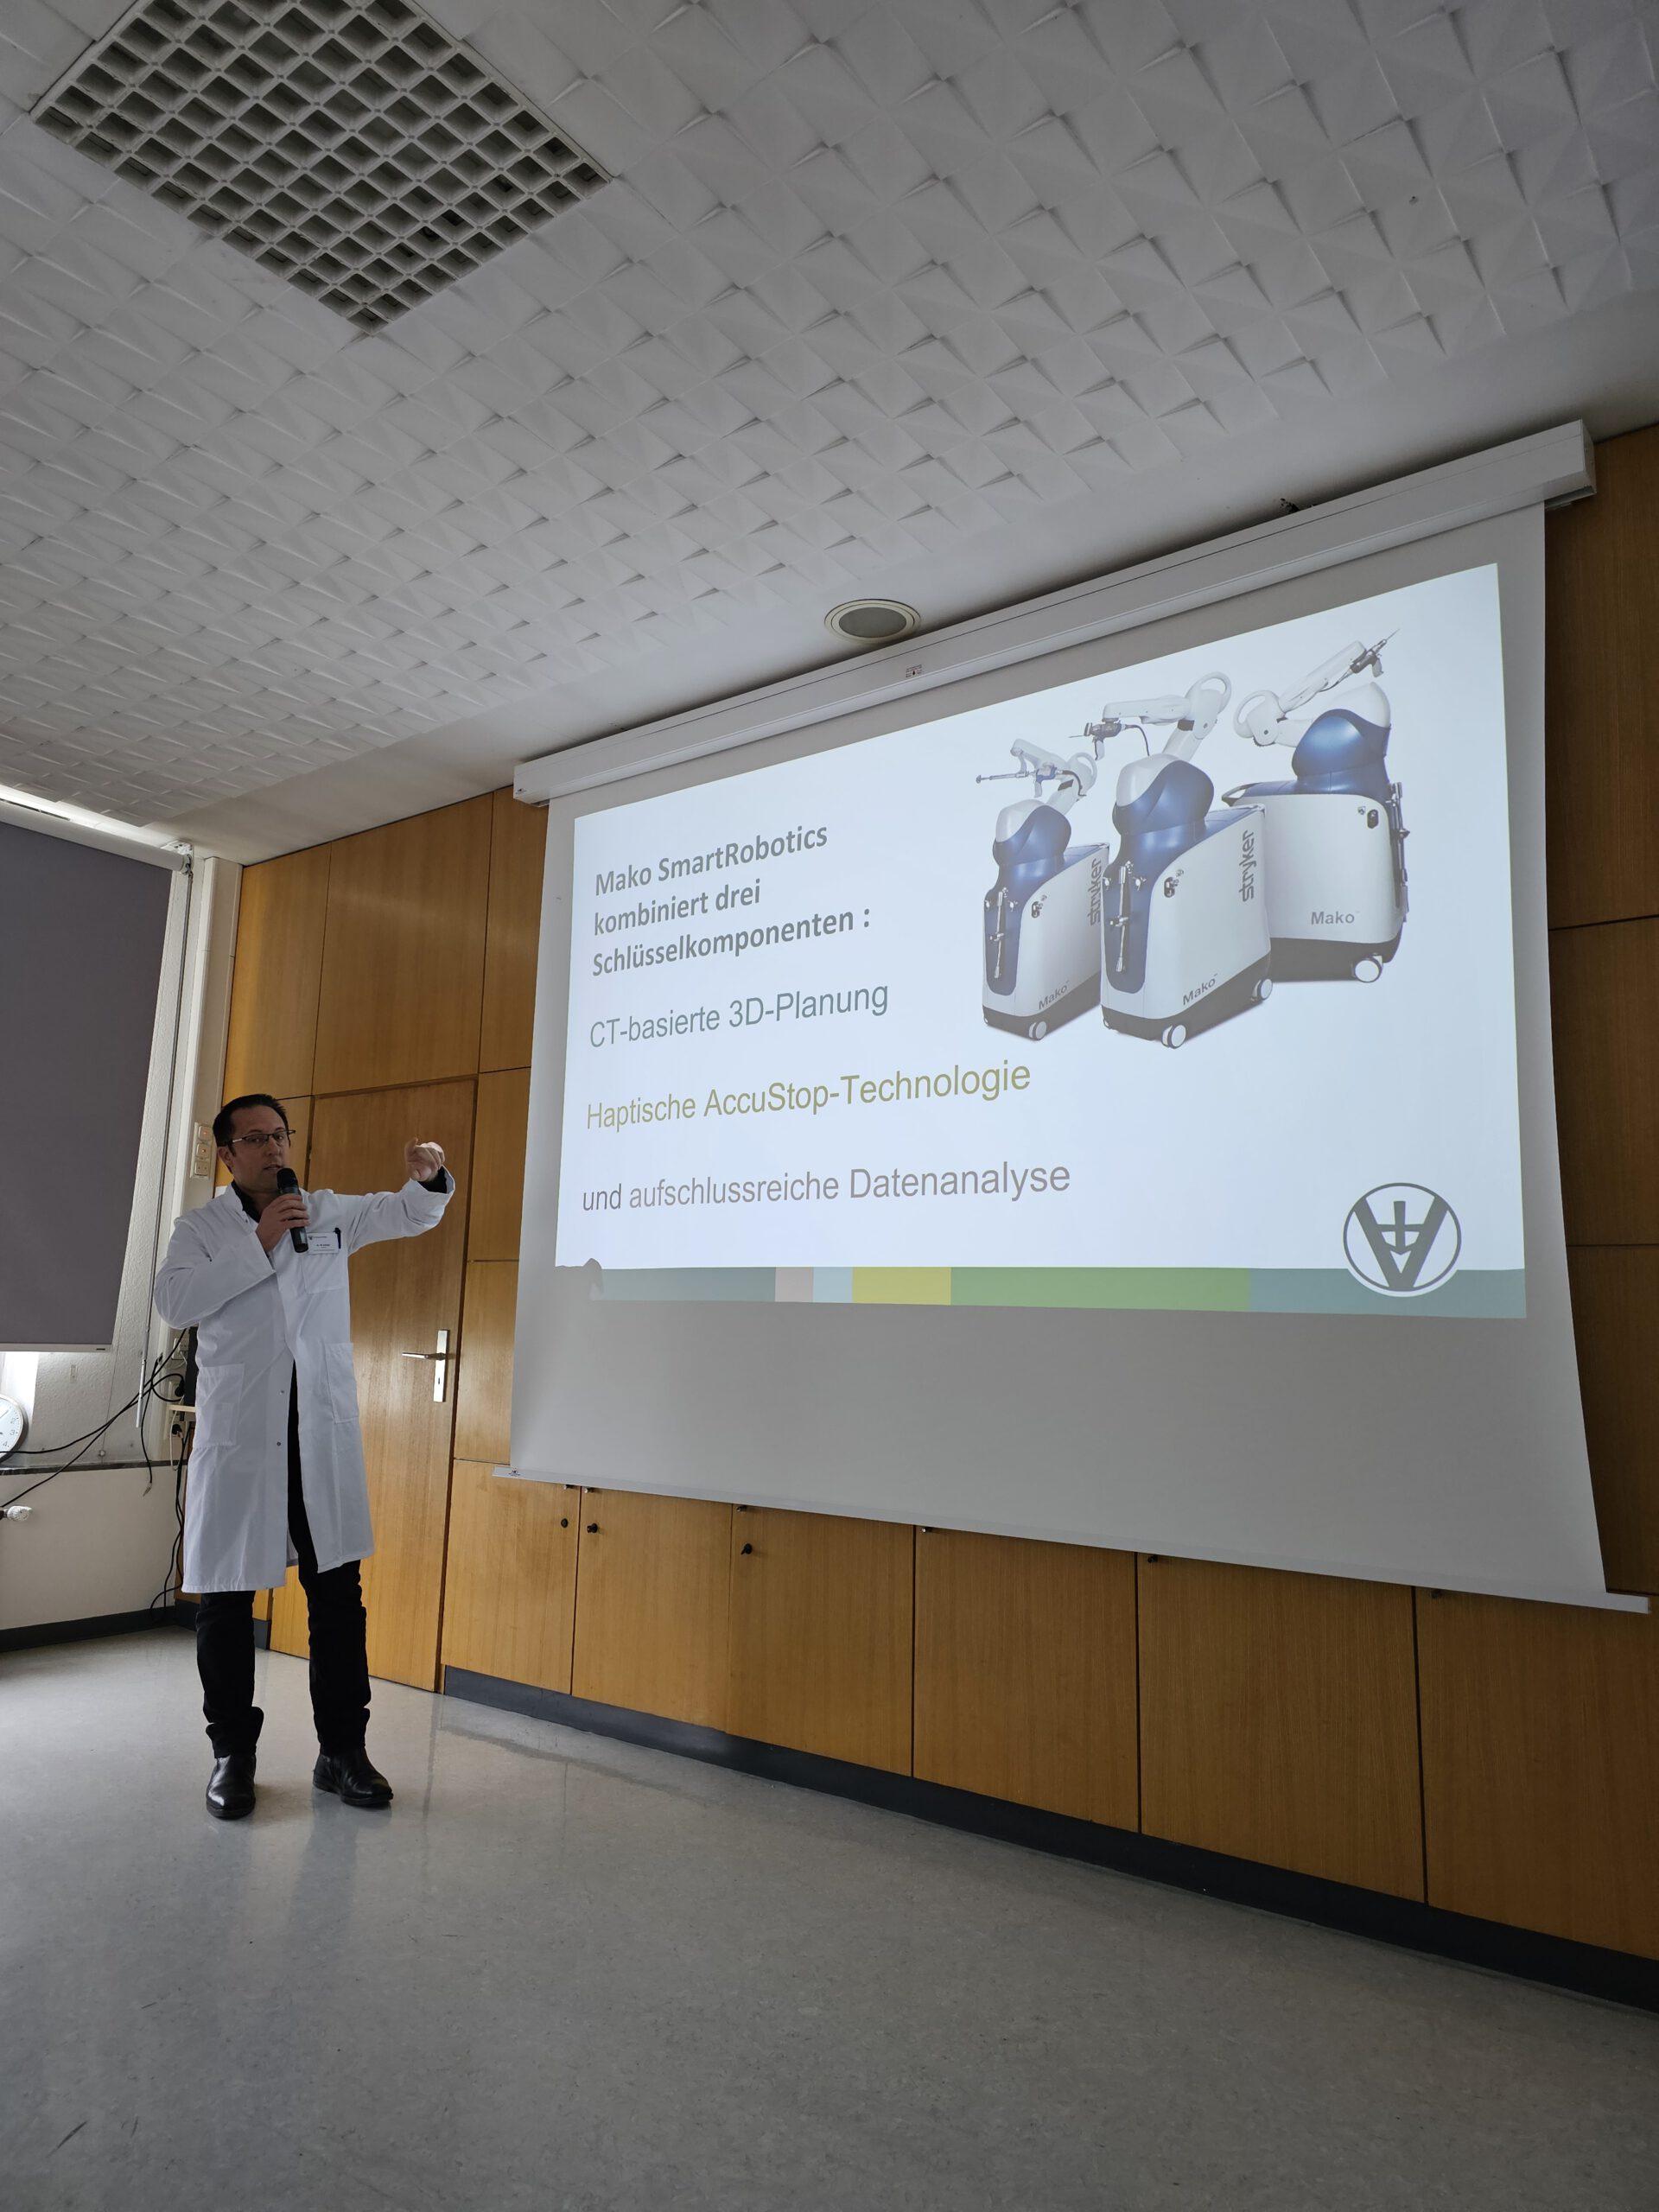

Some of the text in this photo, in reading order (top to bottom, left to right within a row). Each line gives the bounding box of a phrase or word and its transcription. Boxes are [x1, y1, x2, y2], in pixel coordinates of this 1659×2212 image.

[594, 824, 829, 897] Mako SmartRobotics
[1087, 857, 1102, 926] stryker
[1239, 830, 1257, 902] stryker
[594, 878, 761, 937] kombiniert drei
[1311, 911, 1355, 925] Mako
[592, 910, 855, 976] Schlüsselkomponenten
[589, 984, 889, 1049] CT-basierte 3D-Planung
[1039, 985, 1067, 1010] Mako
[1183, 978, 1216, 1006] Mako
[586, 1059, 1032, 1134] Haptische AccuStop-Technologie
[582, 1160, 1071, 1211] und aufschlussreiche Datenanalyse
